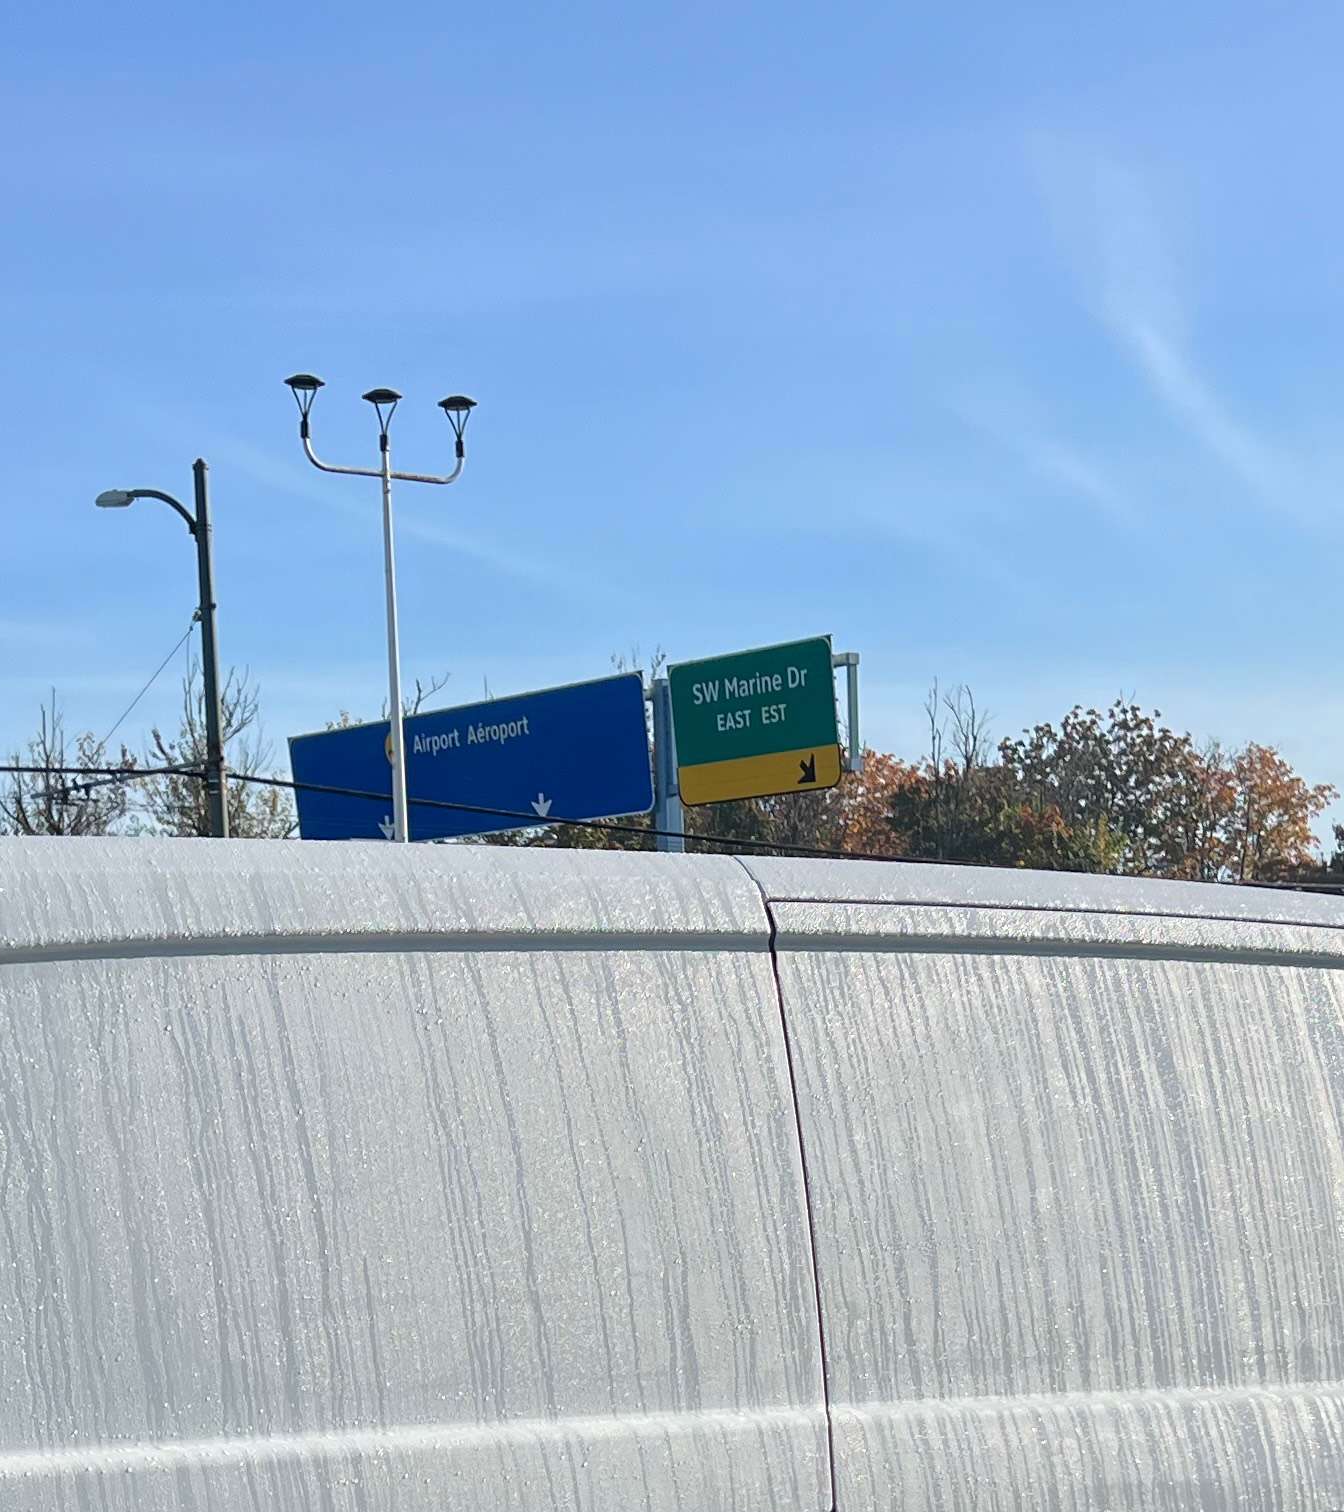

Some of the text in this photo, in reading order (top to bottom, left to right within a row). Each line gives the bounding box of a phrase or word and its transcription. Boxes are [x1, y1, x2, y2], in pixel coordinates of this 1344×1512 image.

[692, 666, 808, 704] SW Marine Dr
[413, 716, 530, 756] Airport Aéroport
[716, 703, 787, 731] EAST EST
